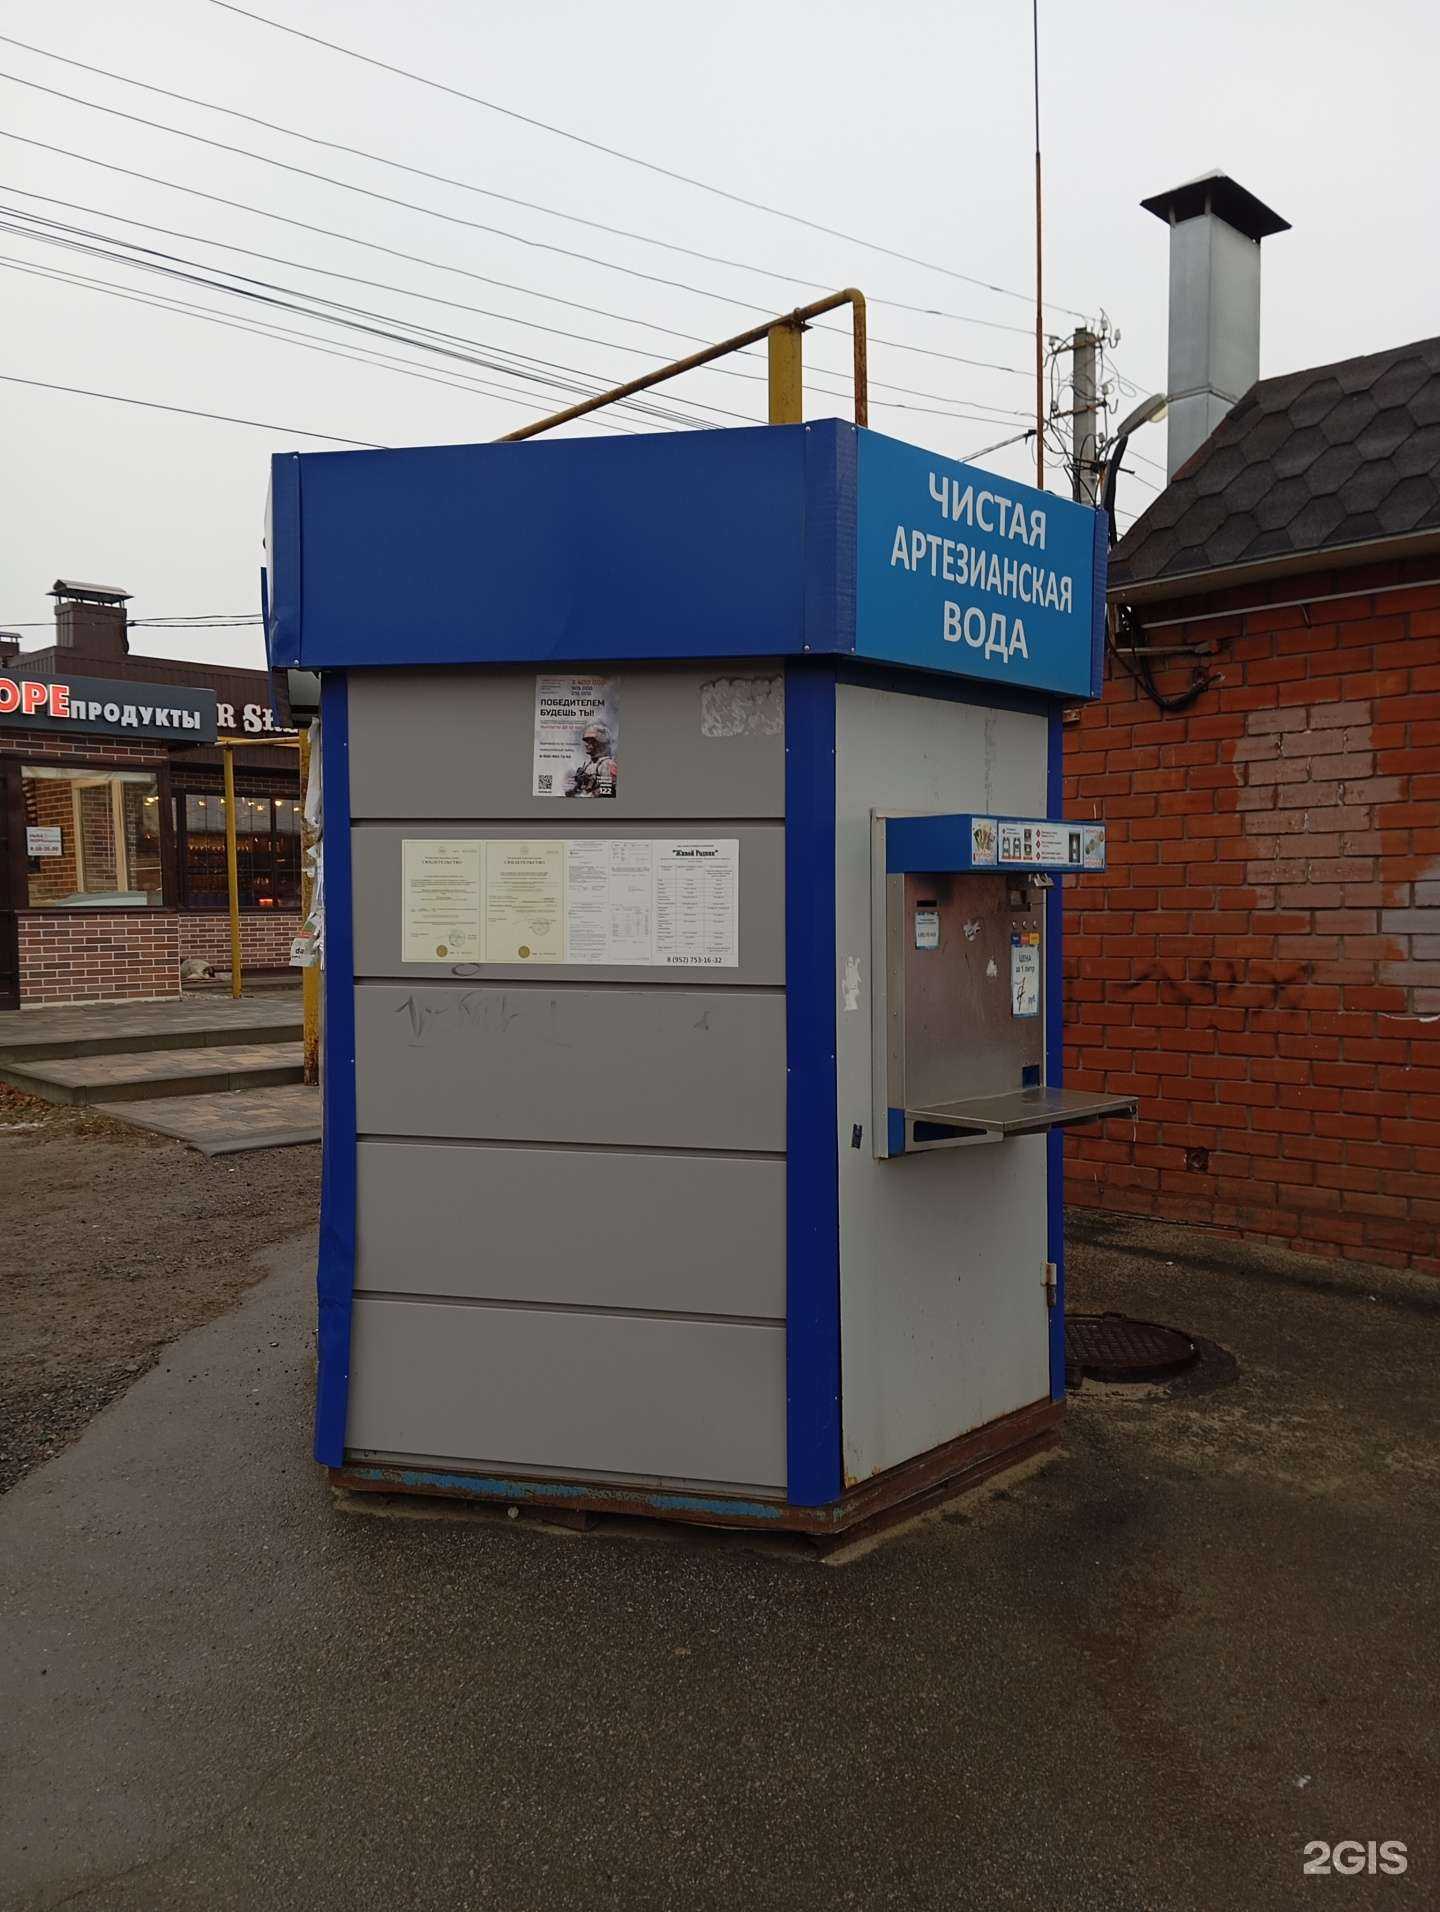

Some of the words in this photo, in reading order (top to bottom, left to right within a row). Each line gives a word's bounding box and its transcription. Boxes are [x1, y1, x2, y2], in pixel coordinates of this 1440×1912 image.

[929, 472, 1047, 550] ЧИСТАЯ
[890, 525, 1073, 613] АРТЕЗИАНСКАЯ
[943, 600, 1029, 663] ВОДА
[540, 698, 605, 707] ПОБЕДИТЕЛЕМ
[540, 709, 576, 717] БУДЕШЬ
